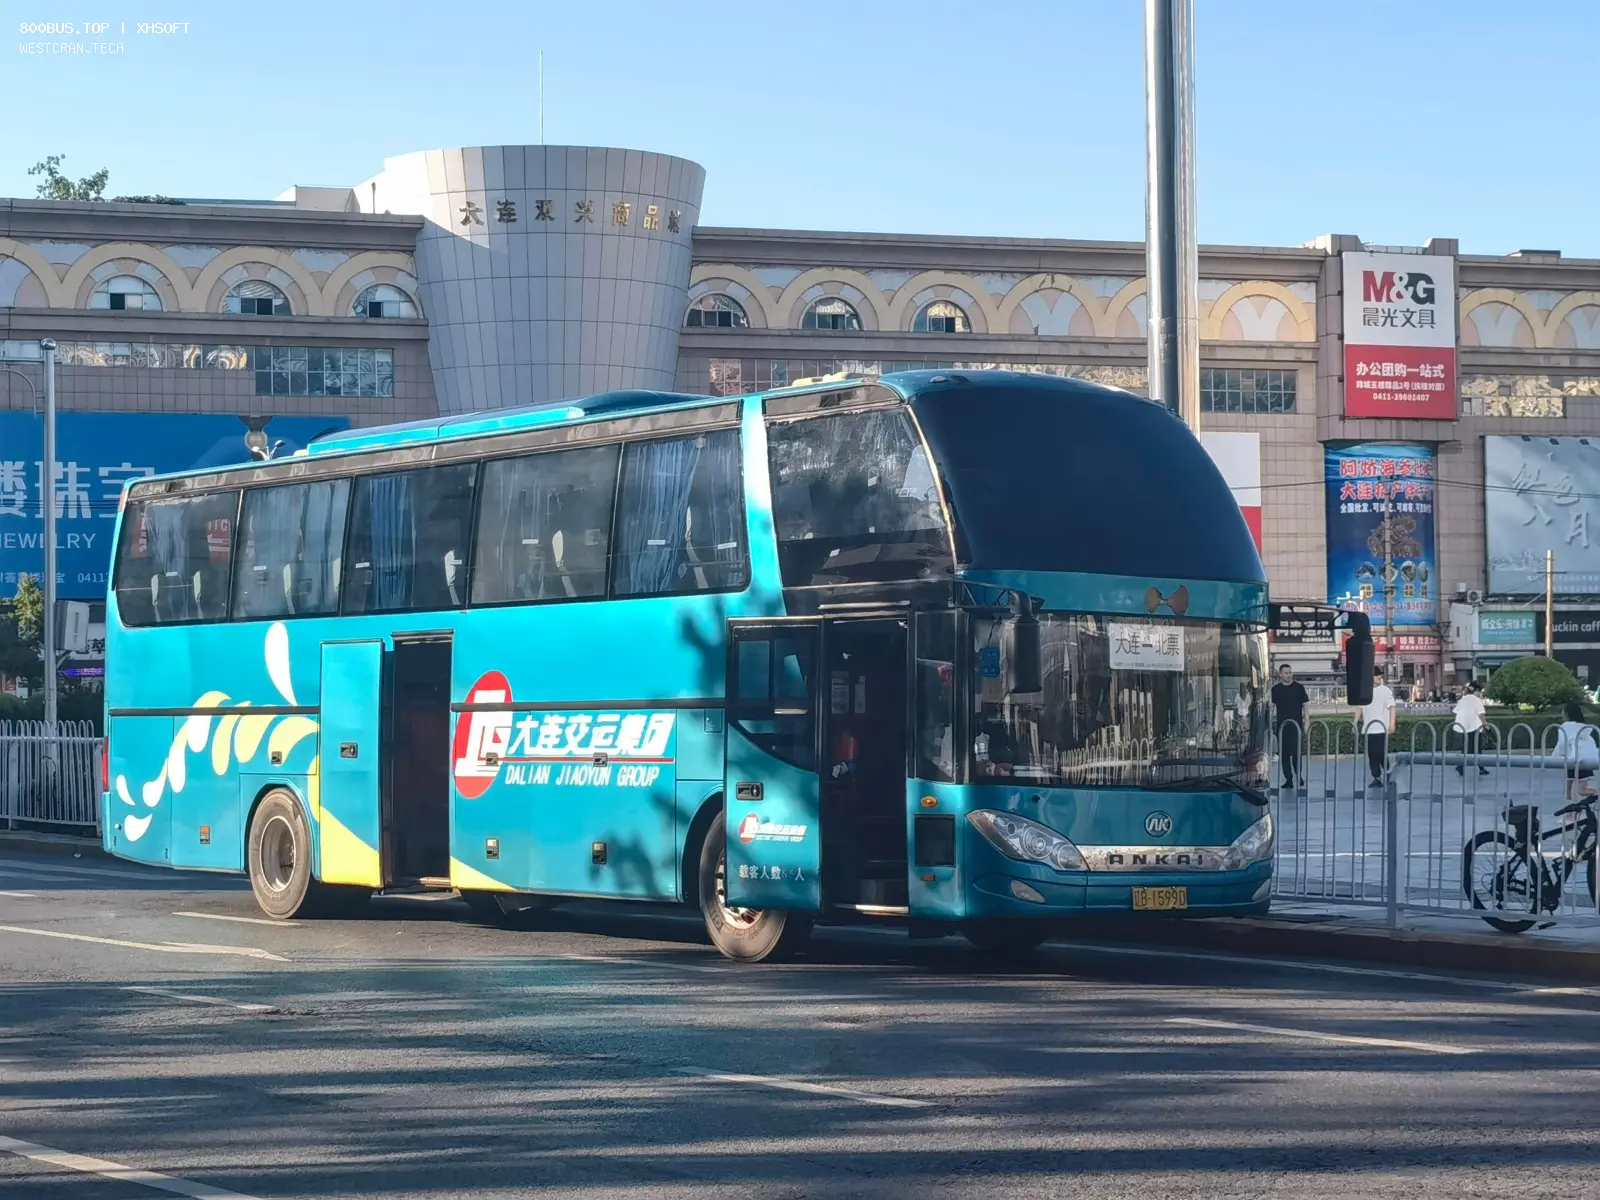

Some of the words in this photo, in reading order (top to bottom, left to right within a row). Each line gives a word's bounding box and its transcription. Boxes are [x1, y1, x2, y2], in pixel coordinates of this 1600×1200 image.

[1362, 270, 1436, 306] M&G
[1362, 307, 1436, 329] 晨光文具
[1356, 362, 1445, 378] 办公团购一站式
[1552, 621, 1579, 632] uckin
[508, 713, 676, 756] 大连交运集团
[505, 765, 551, 785] DALIAN
[556, 765, 612, 786] JIAOYUN
[616, 765, 660, 787] GROUP
[1109, 854, 1204, 866] ANKAI
